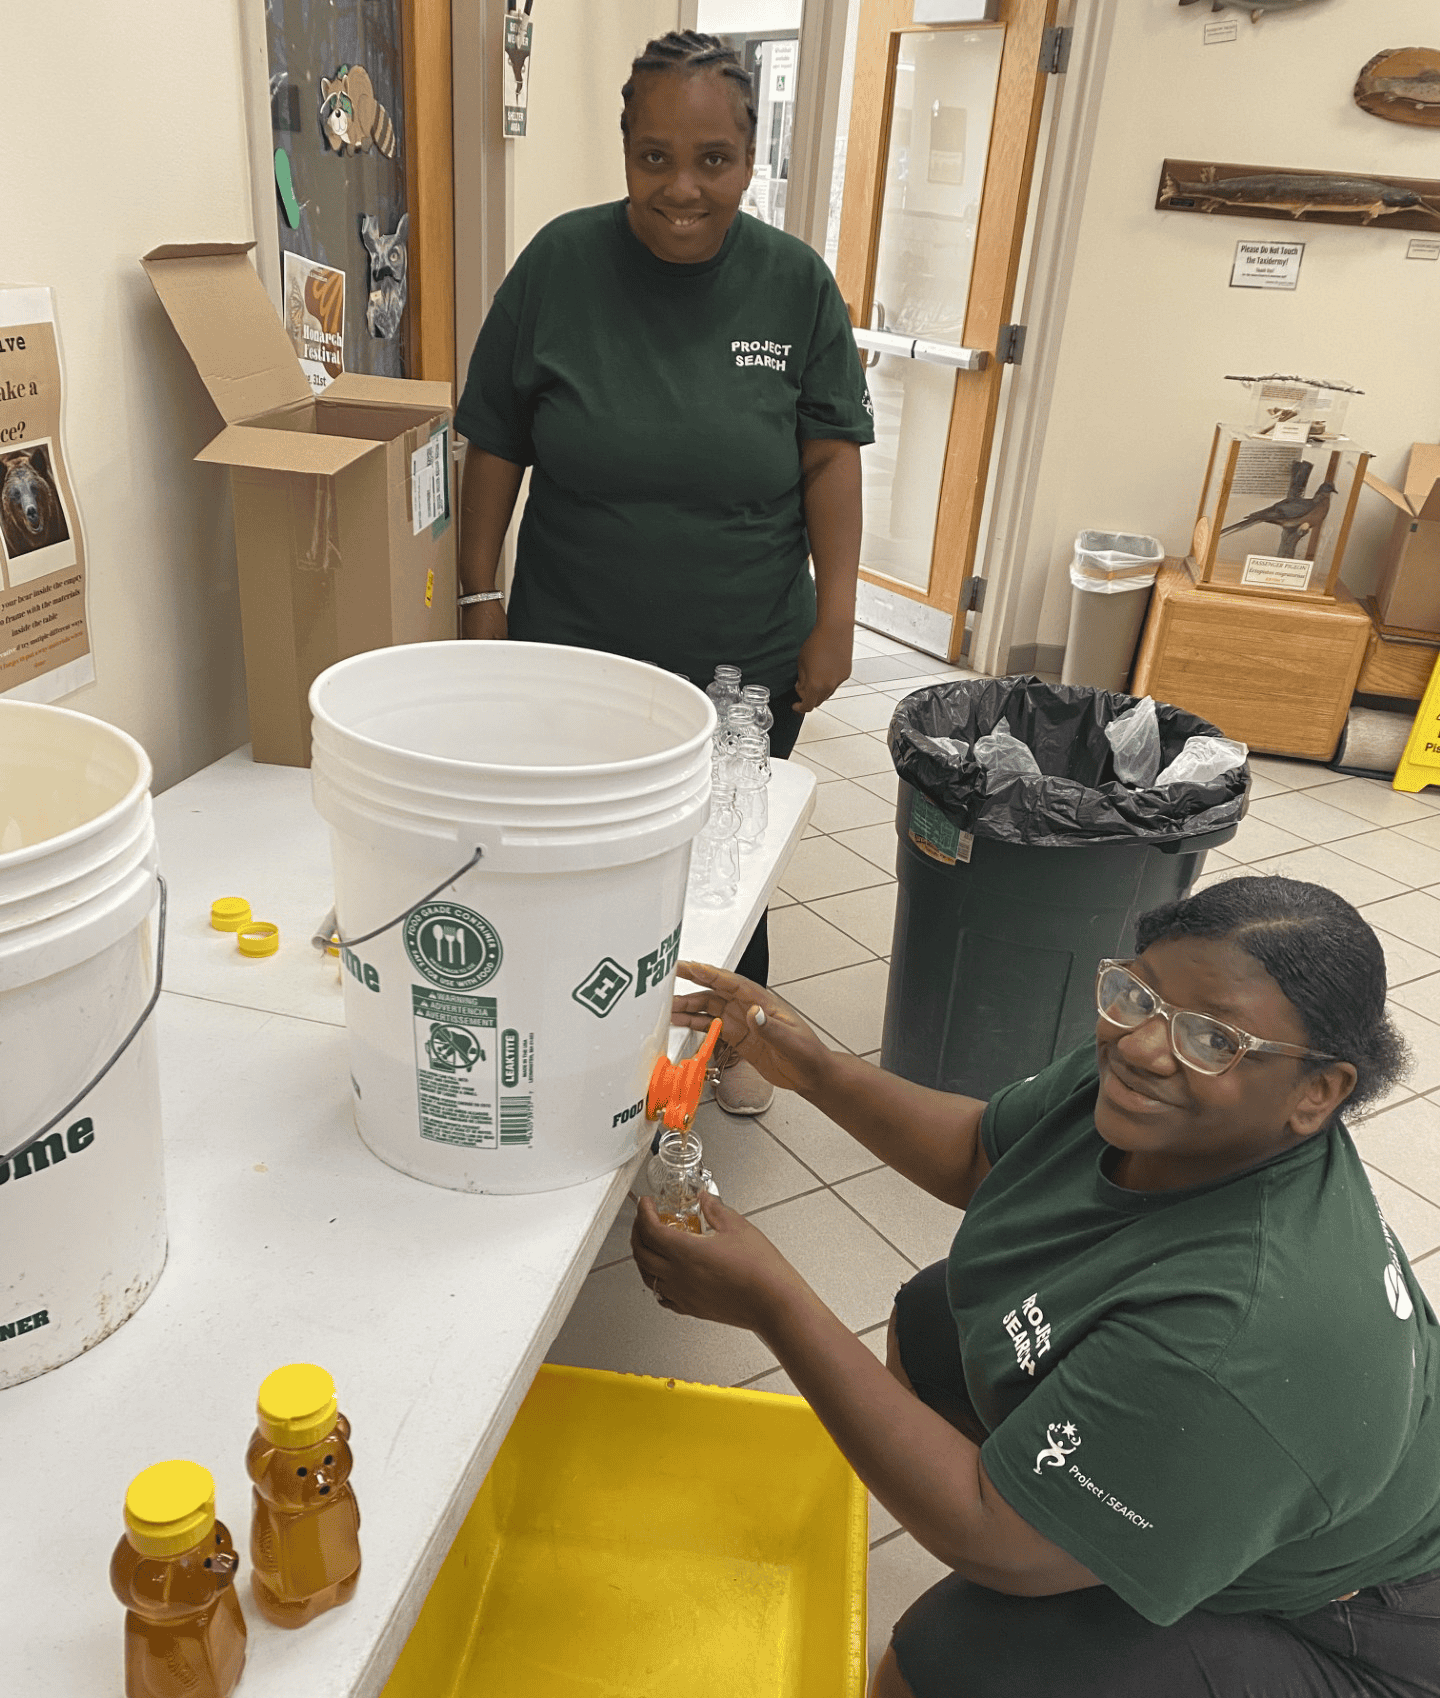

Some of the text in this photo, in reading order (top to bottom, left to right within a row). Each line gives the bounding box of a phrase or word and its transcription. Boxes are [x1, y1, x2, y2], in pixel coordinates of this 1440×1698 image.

[1240, 245, 1299, 255] Please Do Not Touch
[1246, 256, 1289, 267] the Taxidermy!
[303, 324, 342, 348] Monarch
[304, 343, 341, 365] Festival
[731, 340, 792, 356] PROJECT
[735, 354, 786, 372] SEARCH
[313, 373, 326, 386] 31st
[29, 381, 38, 396] a
[408, 906, 497, 948] FOOD GRADE CONTAINER
[411, 949, 425, 967] SAFE
[424, 967, 439, 980] FOR
[439, 977, 455, 987] USE
[456, 978, 478, 987] WITH
[476, 962, 494, 981] FOOD
[436, 993, 478, 1006] WARNING
[430, 1002, 489, 1016] ADVERTENCIA
[425, 1010, 494, 1027] AVERTISSEMENT
[505, 1035, 515, 1082] LEAKTITE
[612, 1099, 644, 1128] FOOD
[1068, 1464, 1104, 1498] Project
